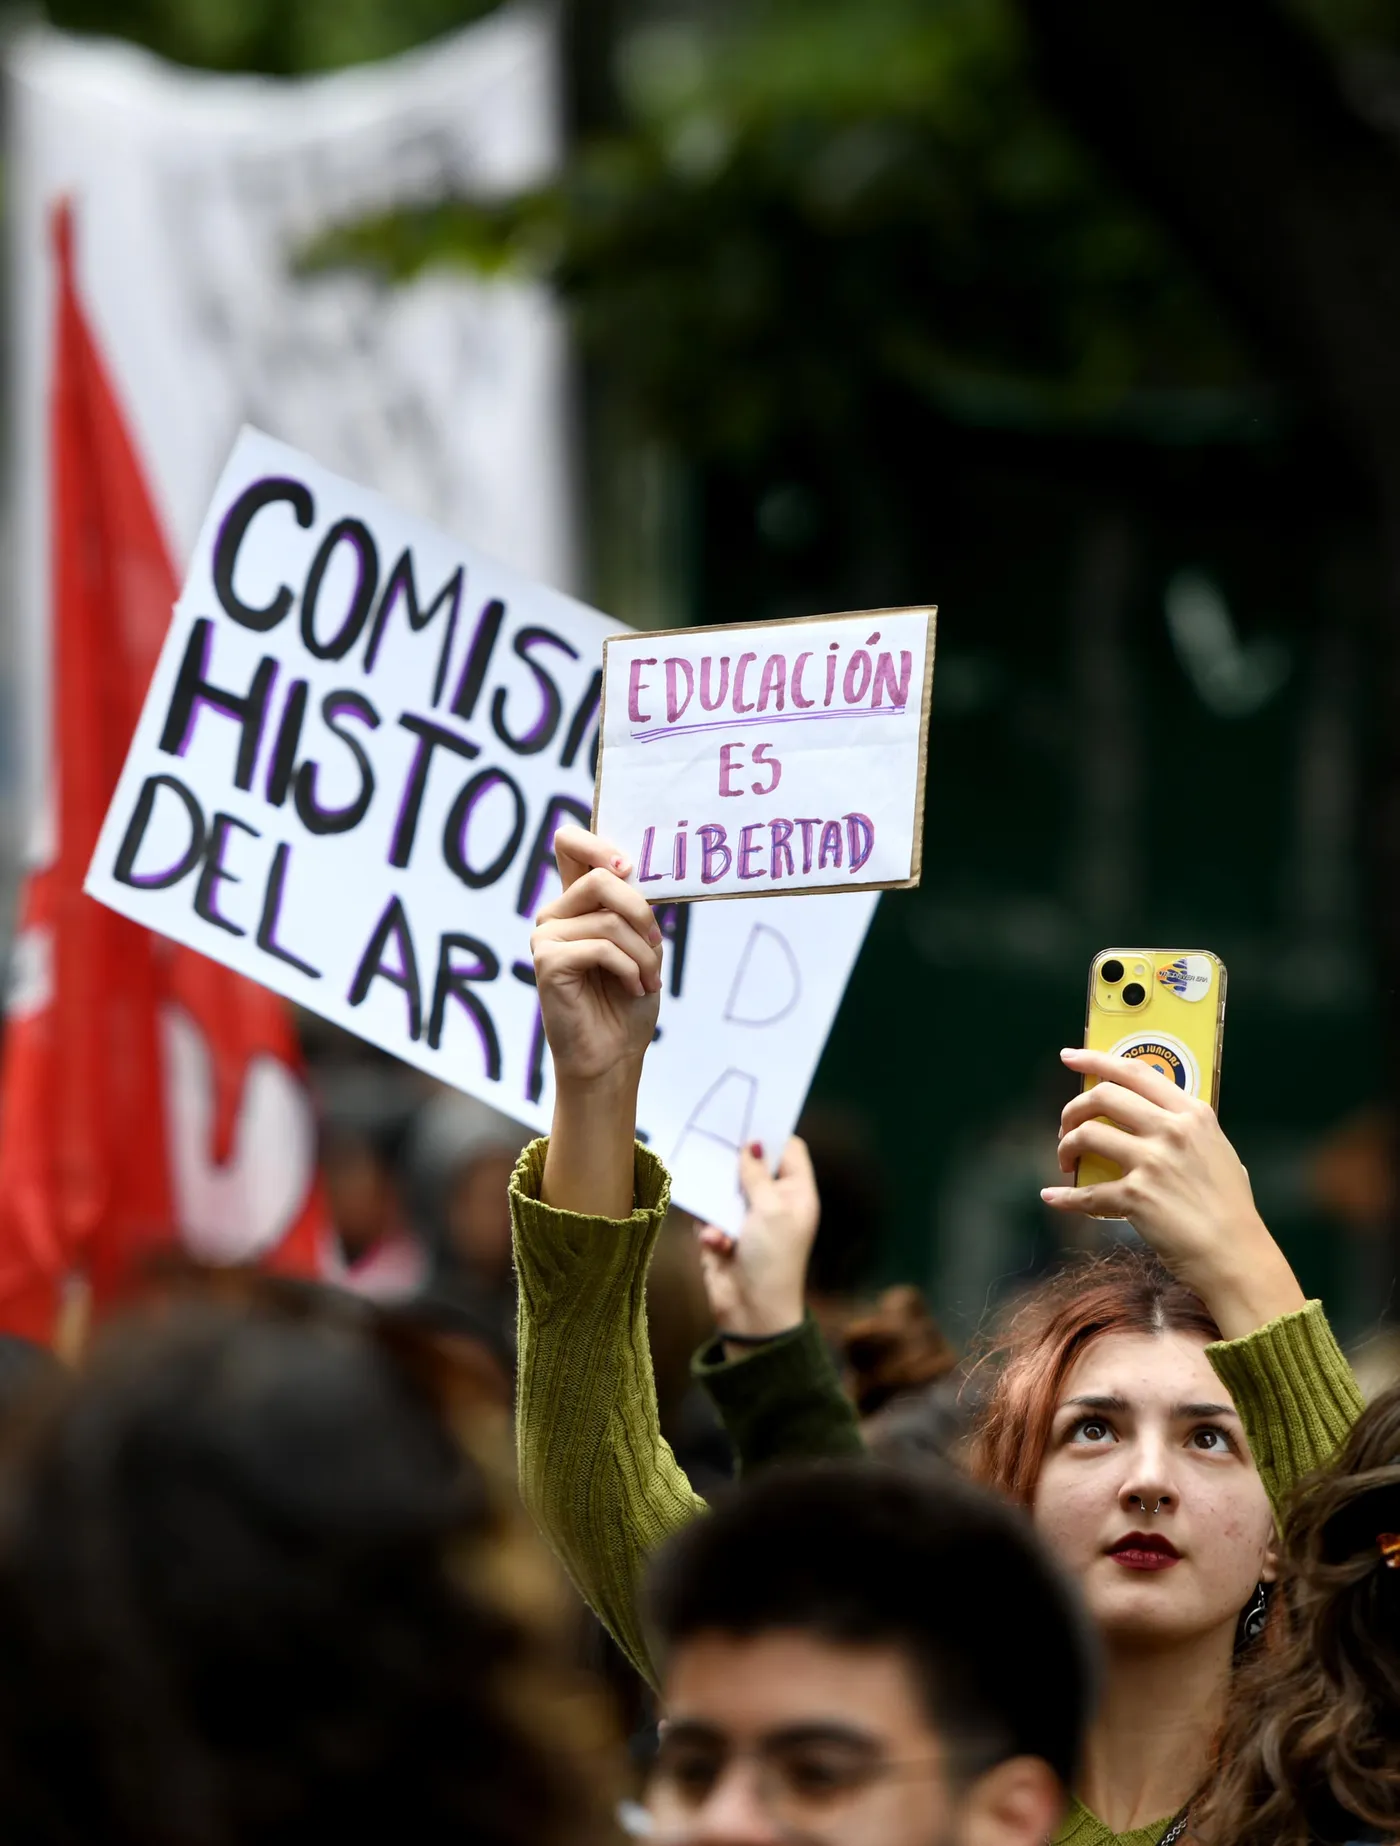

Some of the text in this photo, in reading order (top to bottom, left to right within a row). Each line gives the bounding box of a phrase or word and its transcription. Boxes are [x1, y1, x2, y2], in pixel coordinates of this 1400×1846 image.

[211, 473, 605, 786] COMISI
[717, 741, 783, 798] ES
[112, 773, 323, 978] DEL
[1122, 1044, 1180, 1068] OCA JUNIORS
